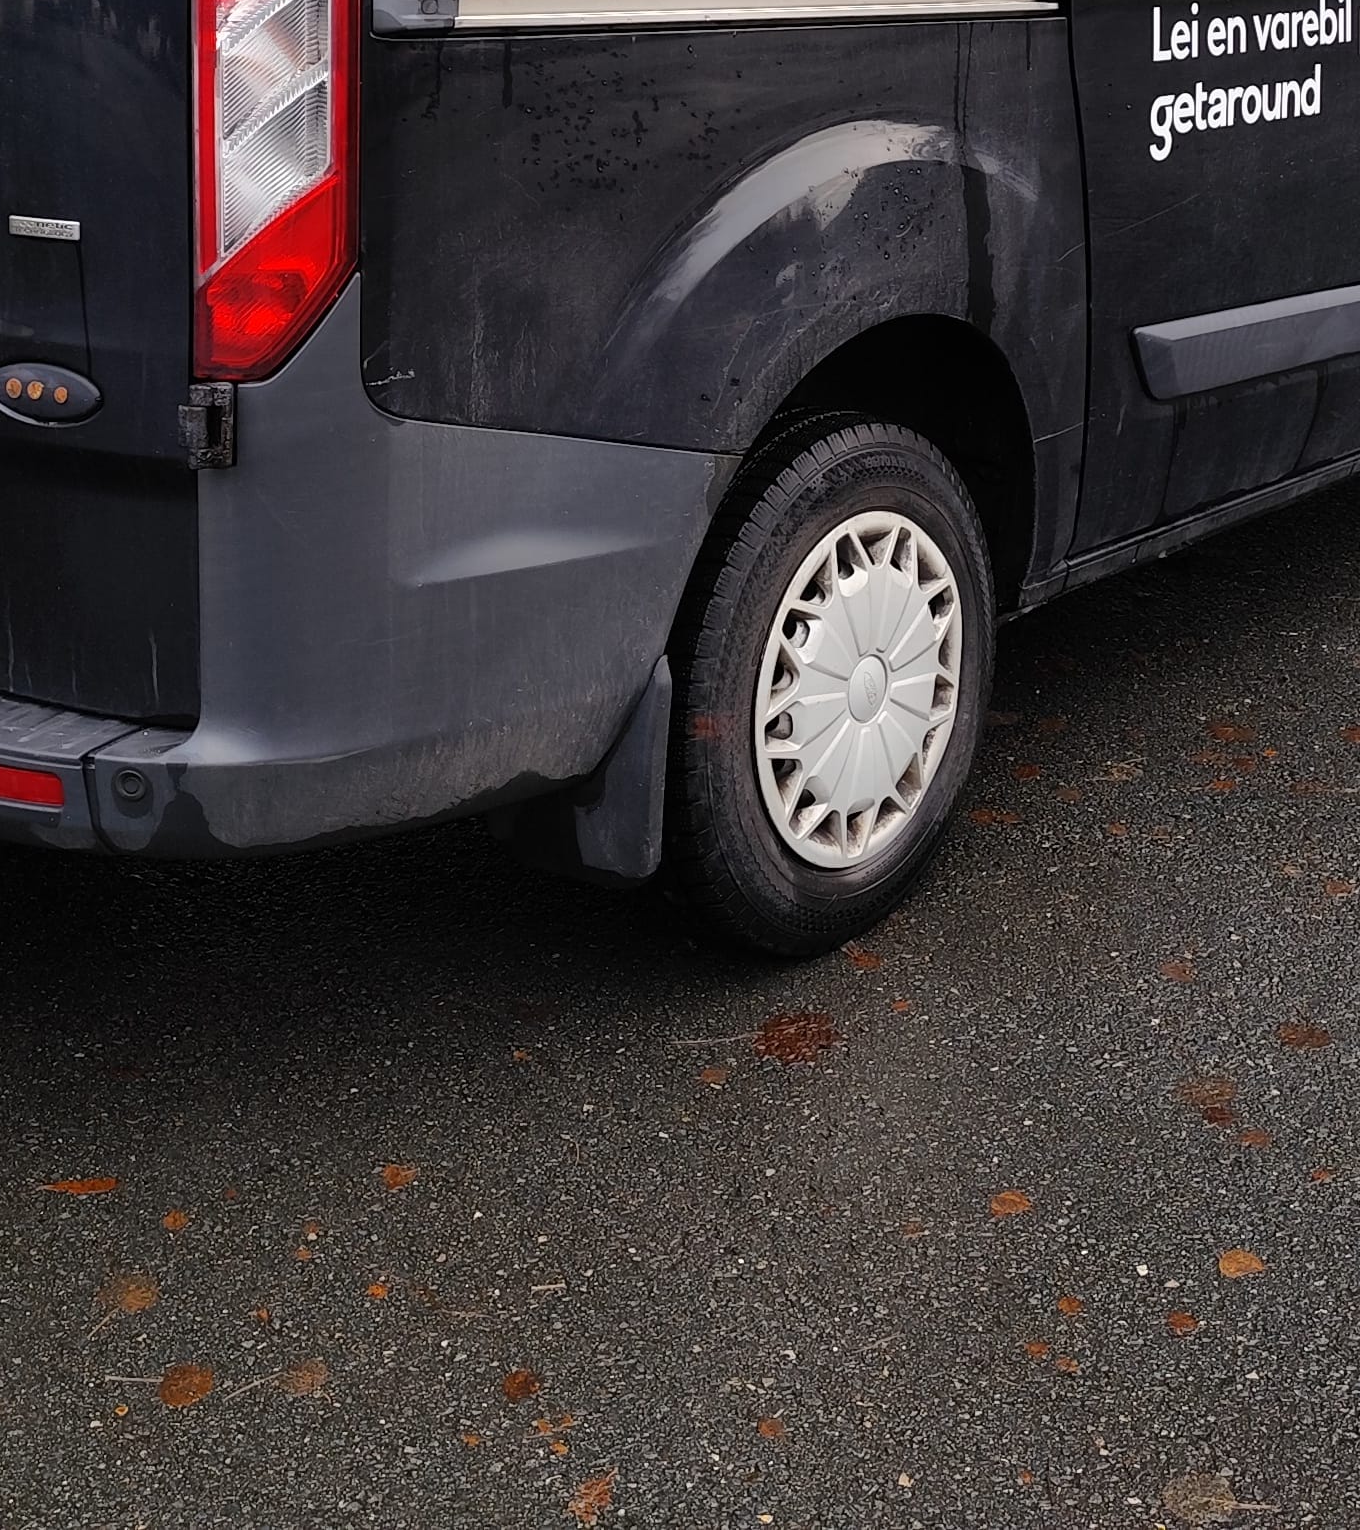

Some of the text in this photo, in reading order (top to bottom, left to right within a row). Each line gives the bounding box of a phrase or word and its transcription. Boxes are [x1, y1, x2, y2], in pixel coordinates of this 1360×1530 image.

[1152, 2, 1199, 62] Lei
[1206, 15, 1247, 57] en
[1149, 63, 1322, 162] getaround
